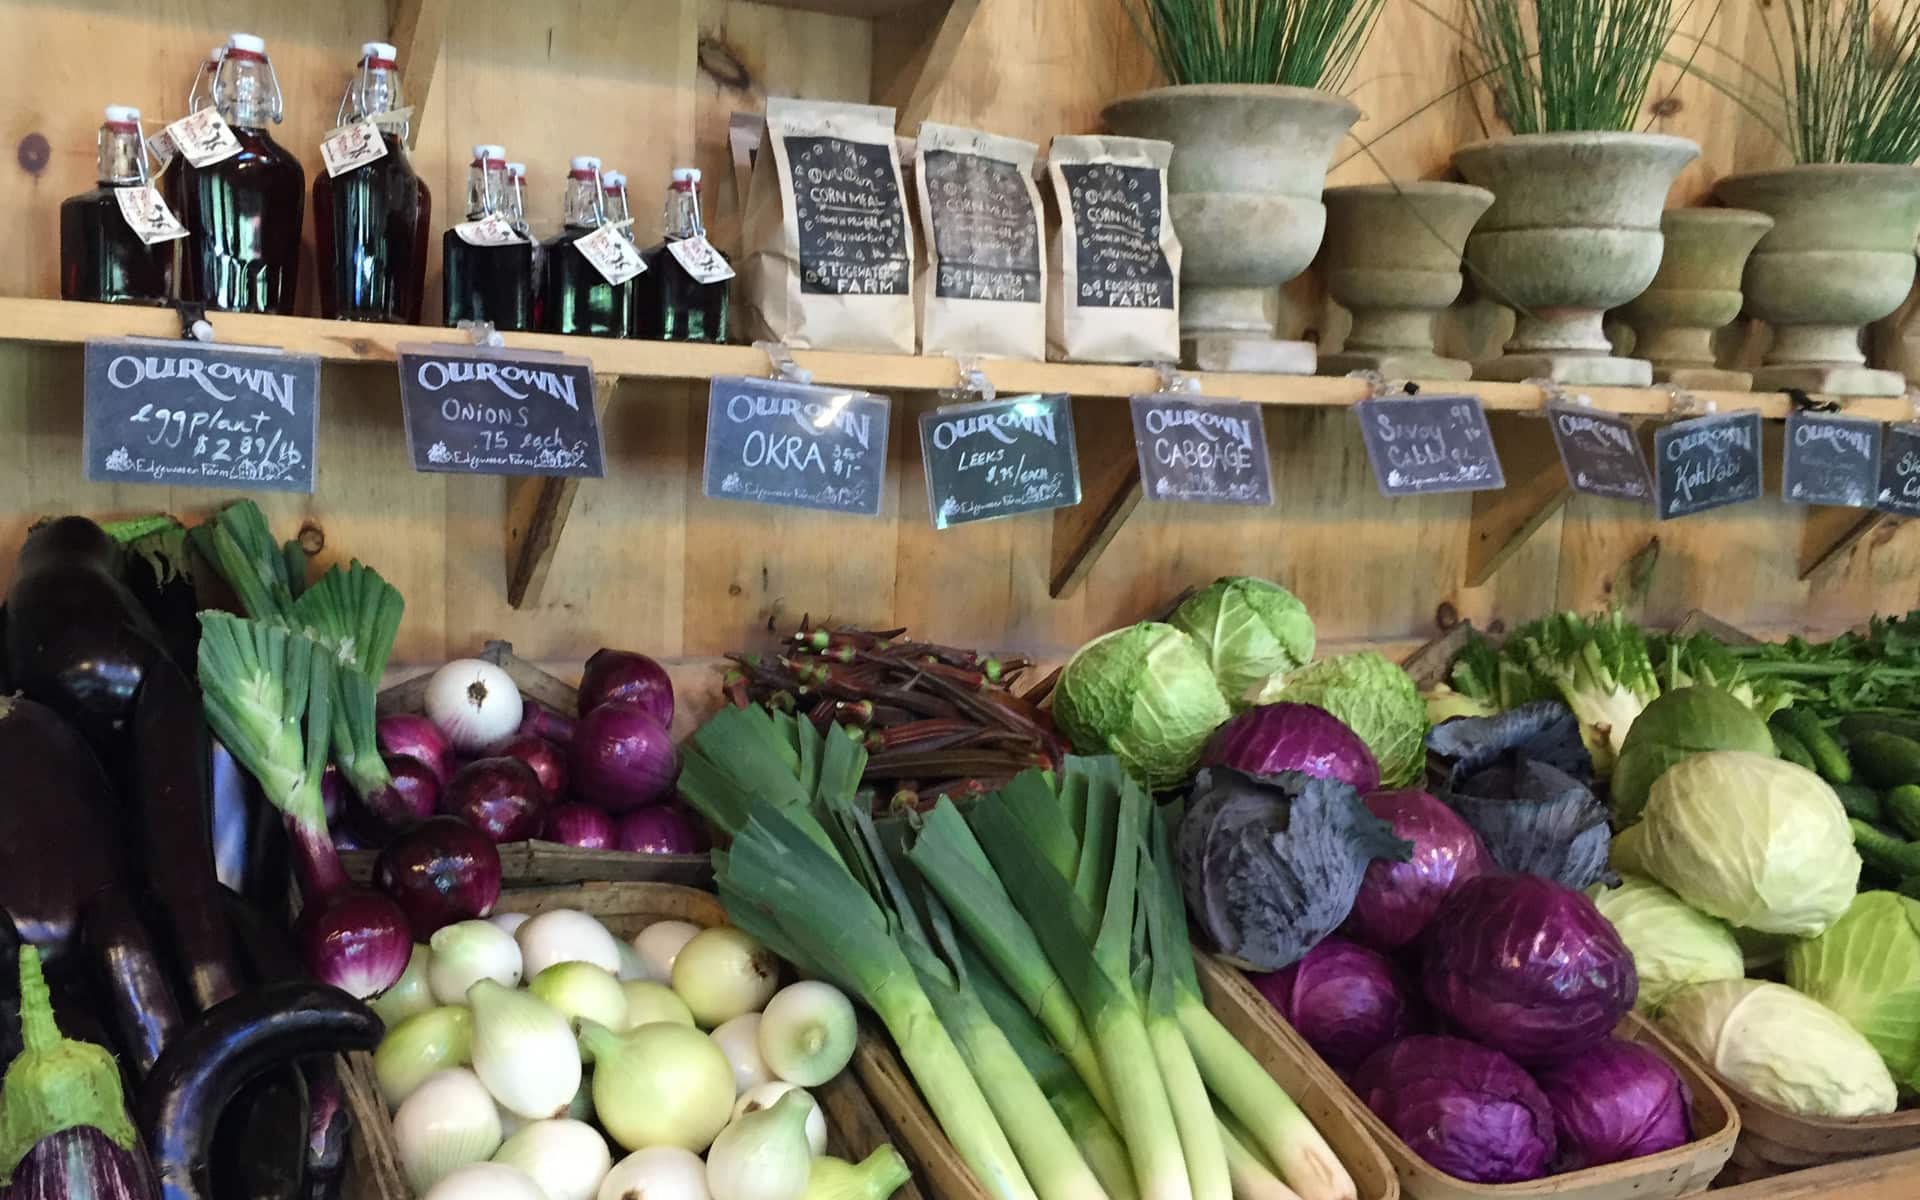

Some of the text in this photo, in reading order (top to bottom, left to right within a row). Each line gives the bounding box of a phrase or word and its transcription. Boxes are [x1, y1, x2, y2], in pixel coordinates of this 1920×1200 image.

[837, 279, 894, 294] FARM
[970, 285, 1025, 301] FARM
[1109, 292, 1161, 307] FARM
[520, 427, 564, 452] each
[742, 430, 826, 474] OKRA
[957, 449, 1005, 472] LEEKS
[1154, 438, 1252, 475] CABBAGE
[201, 463, 229, 478] Farm
